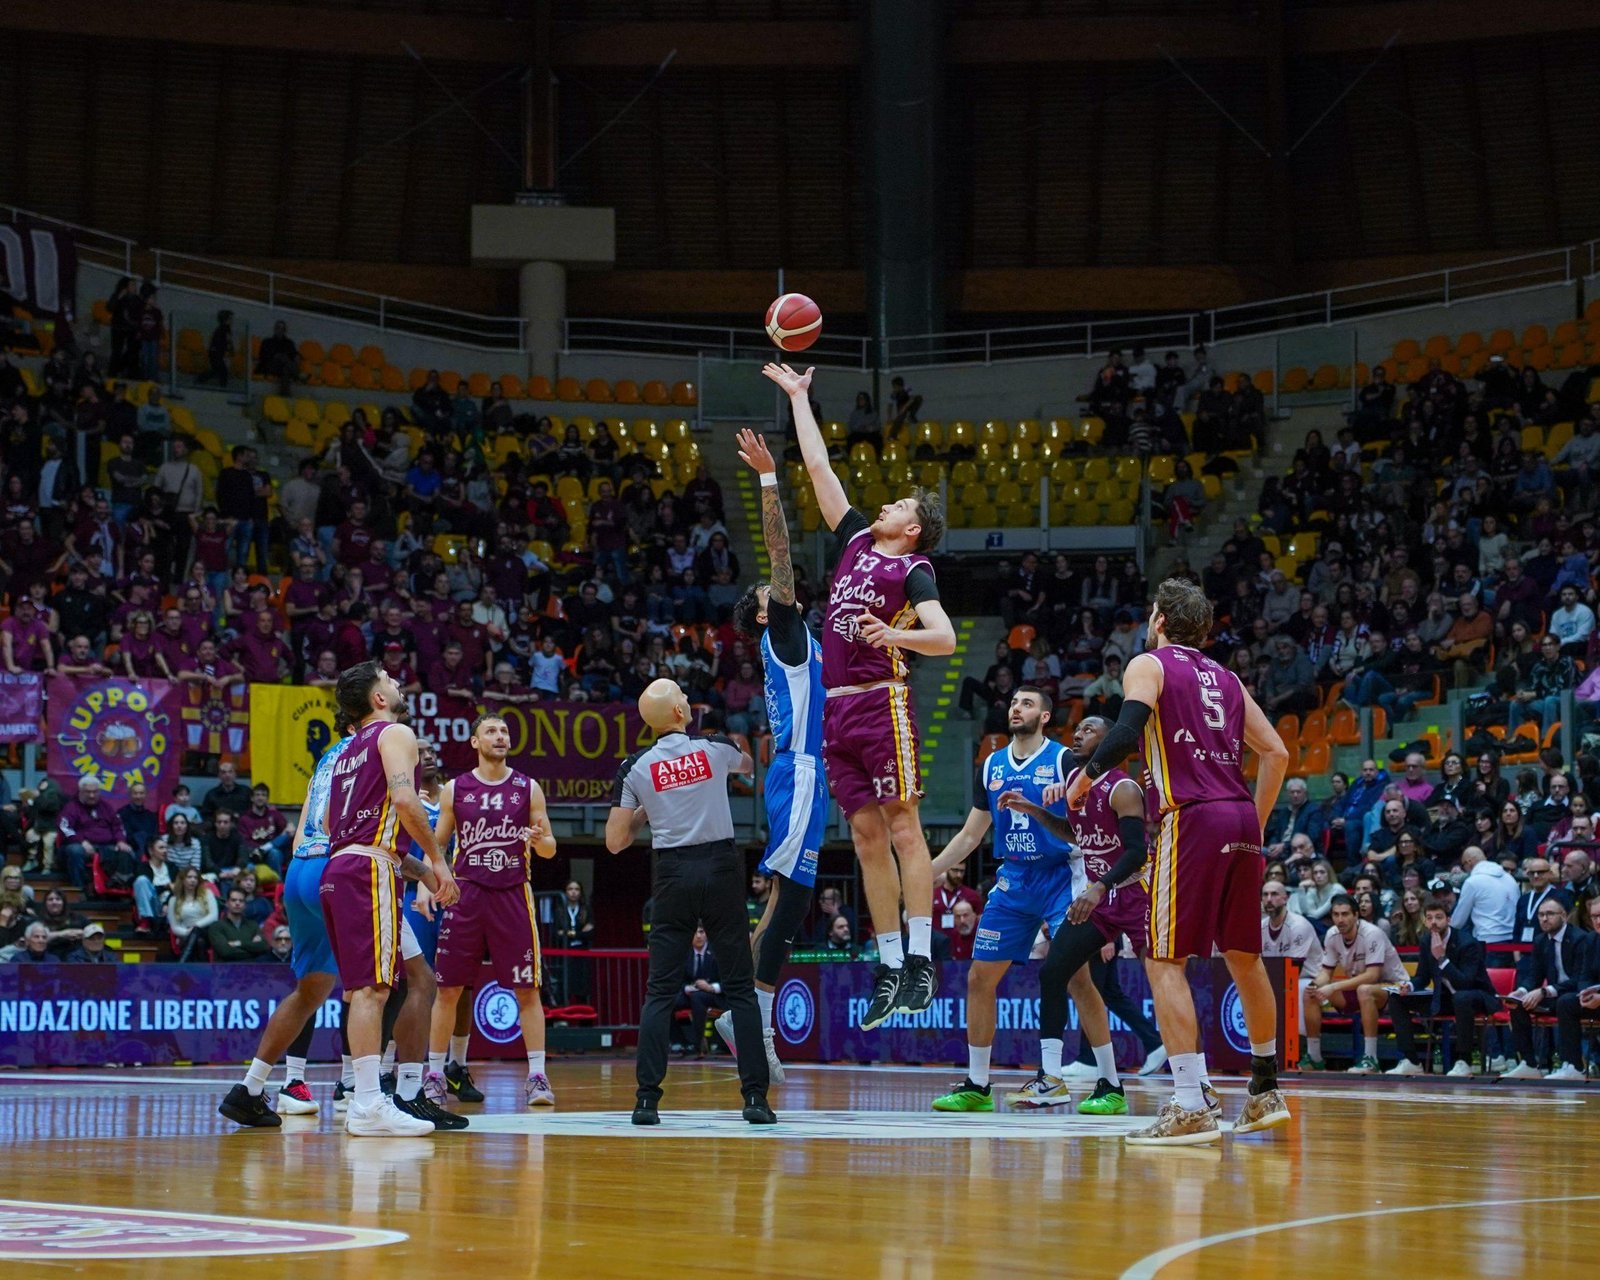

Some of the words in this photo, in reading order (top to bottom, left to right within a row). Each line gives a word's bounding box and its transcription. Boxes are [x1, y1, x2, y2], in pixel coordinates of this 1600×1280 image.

[1200, 685, 1227, 731] 5
[657, 753, 703, 776] ATTAL
[991, 765, 1004, 780] 25
[658, 766, 705, 785] GROUP
[341, 774, 358, 820] 7
[557, 779, 614, 799] MOBY
[480, 792, 503, 811] 14
[1005, 842, 1037, 853] WINES
[511, 965, 534, 983] 14
[140, 999, 260, 1029] LIBERTAS
